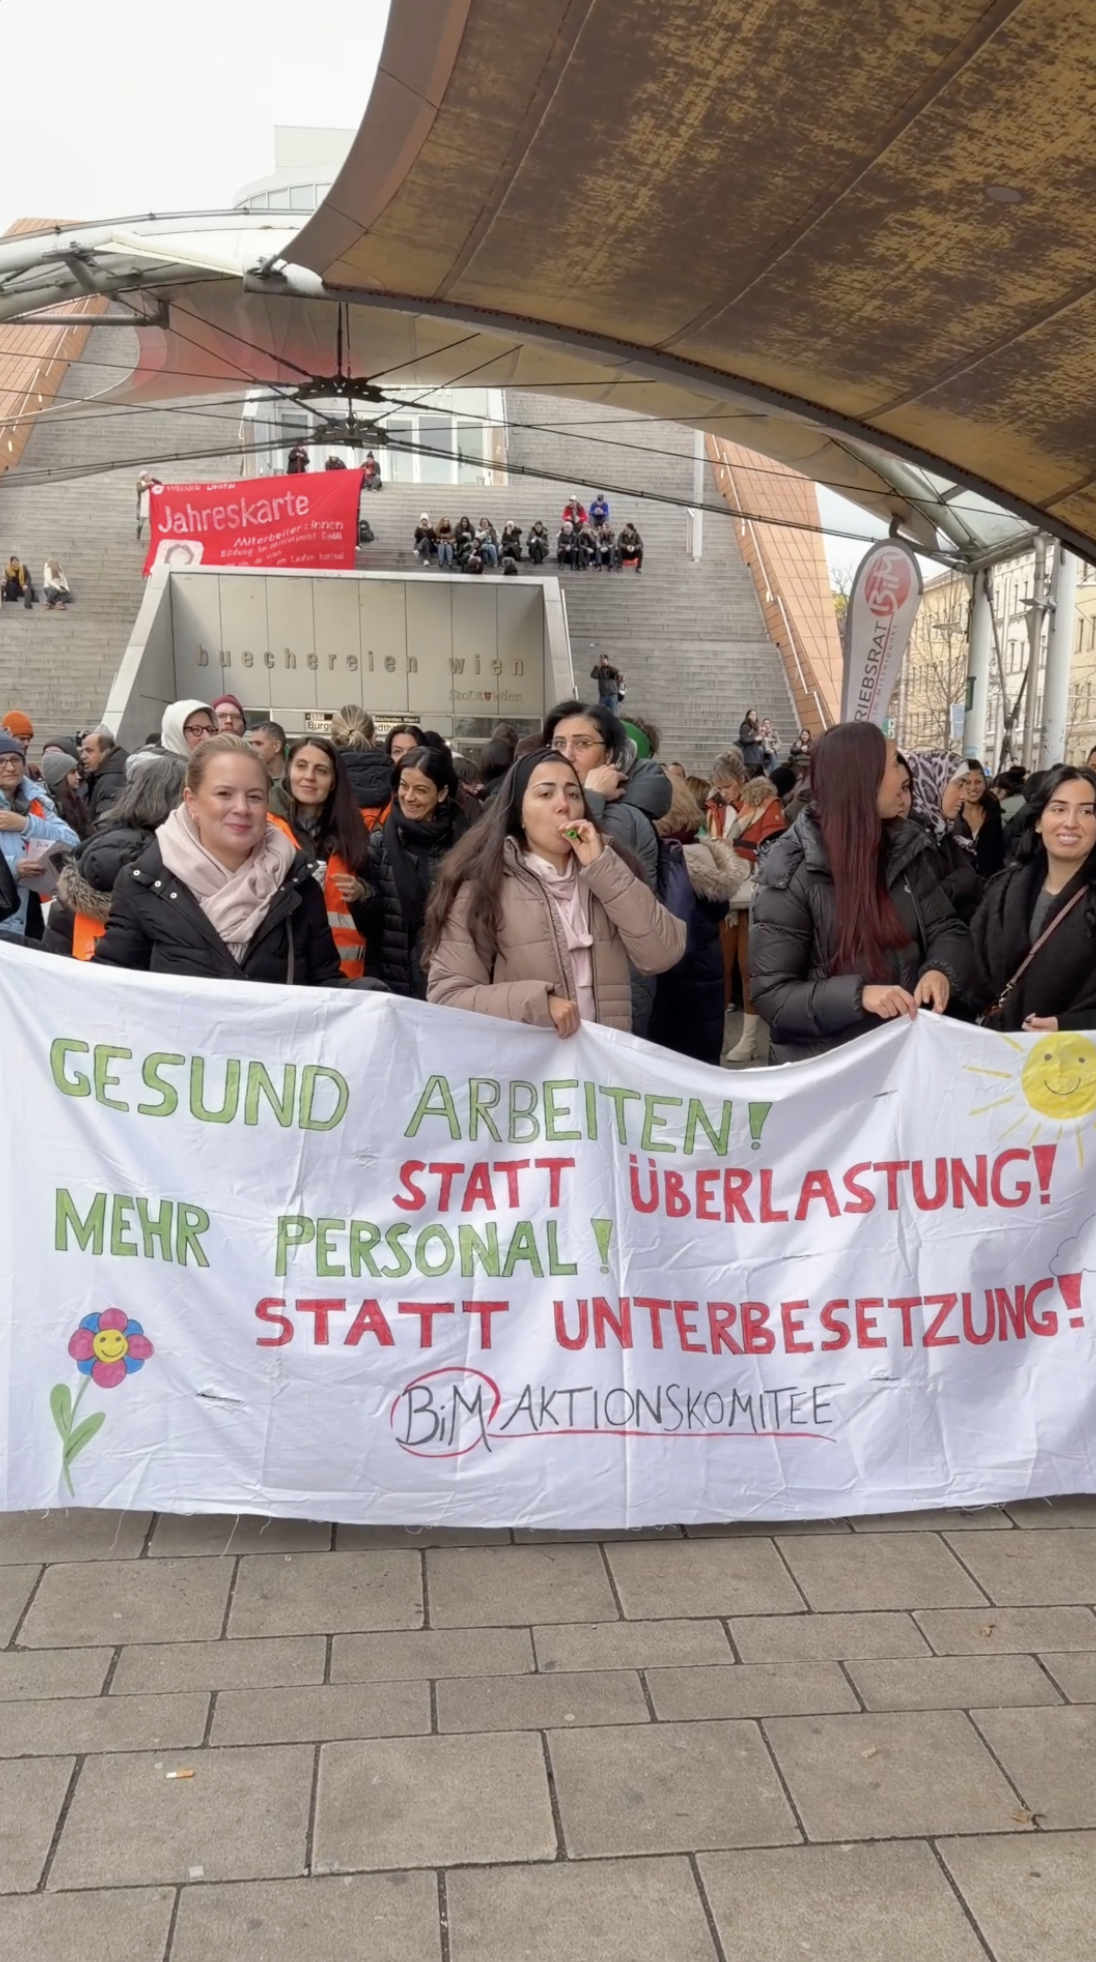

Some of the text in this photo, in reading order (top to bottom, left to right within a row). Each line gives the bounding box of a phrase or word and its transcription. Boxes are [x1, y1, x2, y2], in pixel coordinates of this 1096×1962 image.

[157, 491, 310, 534] Jahreskarte
[220, 548, 253, 558] Bildung
[868, 552, 903, 612] BiM
[194, 643, 525, 676] buechereien wien
[853, 621, 888, 722] RIEBSRAT
[49, 1037, 773, 1157] GESUND ARBEITEN!
[392, 1144, 1057, 1223] STATT ÜBERLASTUNG!
[54, 1188, 211, 1268] MEHR
[255, 1273, 1084, 1356] STATT UNTERBESETZUNG!
[396, 1383, 845, 1452] BiM AKTIONSKOMITEE
